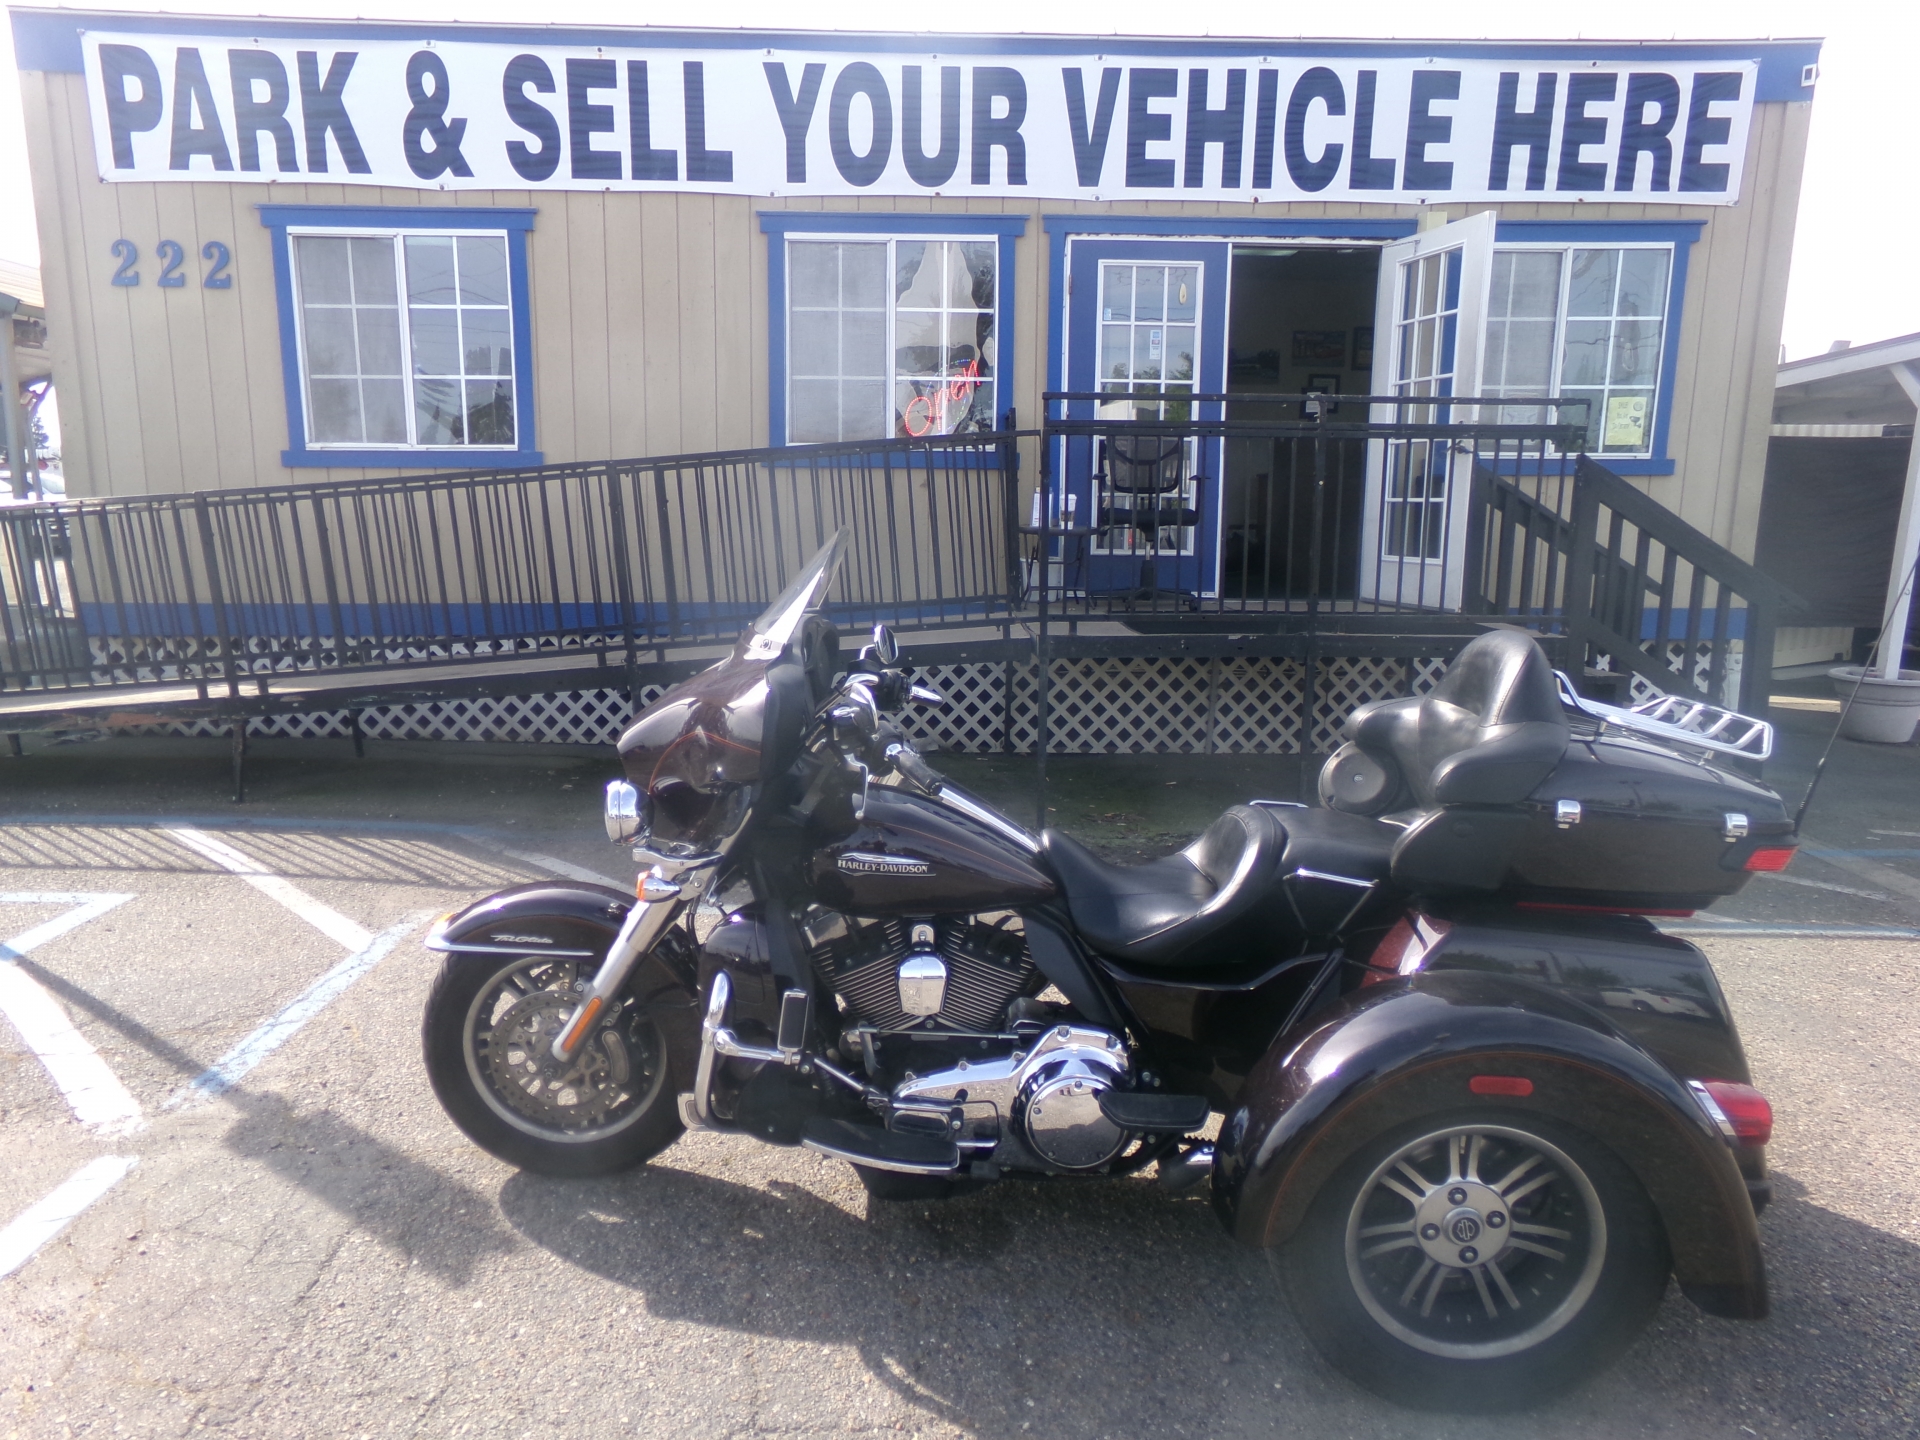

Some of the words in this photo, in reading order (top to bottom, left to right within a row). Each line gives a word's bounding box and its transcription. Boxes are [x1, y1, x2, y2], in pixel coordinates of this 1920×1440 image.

[98, 43, 372, 175] PARK
[402, 49, 475, 181] &
[502, 53, 733, 183] SELL
[762, 61, 1028, 188] YOUR
[1061, 66, 1462, 193] VEHICLE
[1487, 71, 1743, 193] HERE
[110, 238, 232, 289] 222
[837, 859, 929, 874] HARLEY-DAVIDSON
